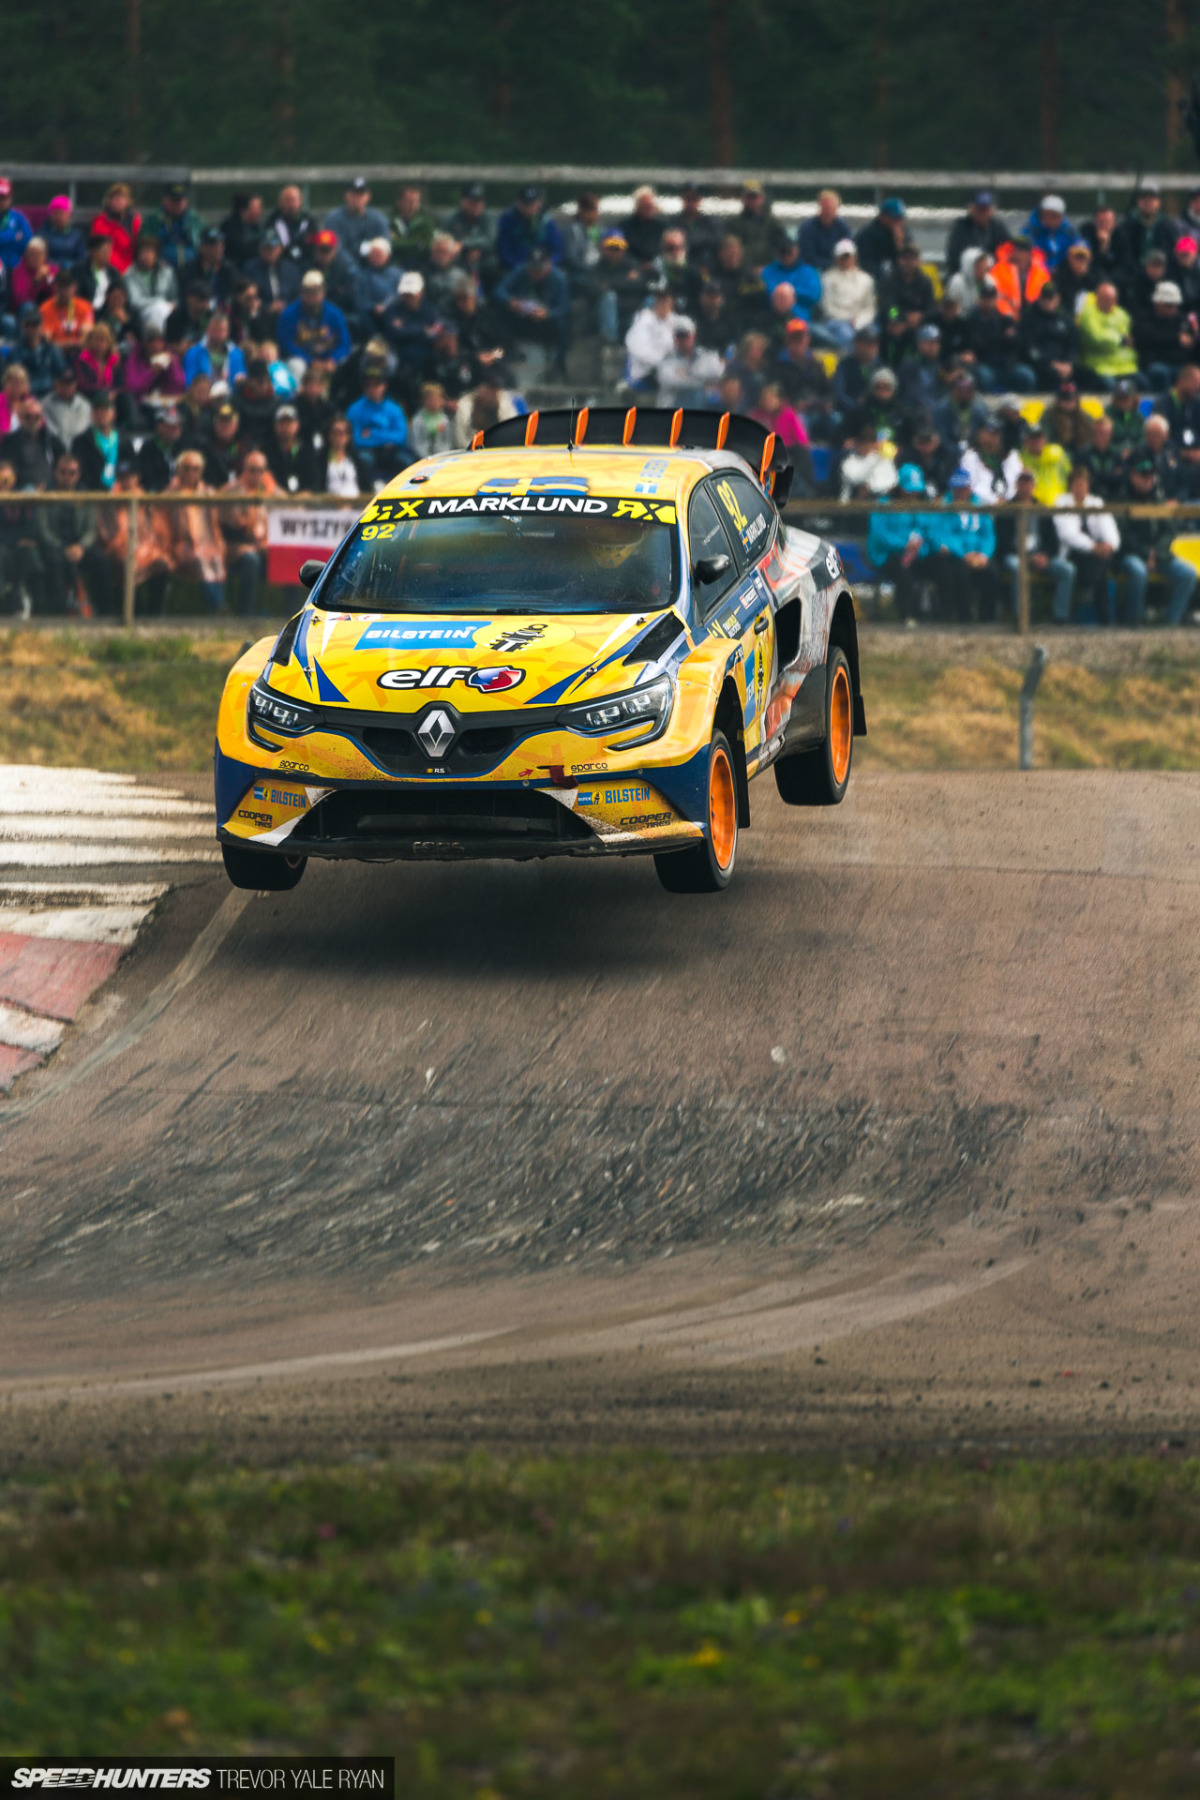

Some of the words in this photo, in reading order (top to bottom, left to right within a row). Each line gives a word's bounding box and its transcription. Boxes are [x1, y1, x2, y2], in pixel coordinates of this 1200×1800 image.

[428, 497, 608, 514] MARKLUND
[716, 480, 748, 531] 92
[361, 523, 396, 541] 92
[378, 665, 474, 690] elf
[279, 760, 310, 772] sparco
[570, 762, 608, 773] sparco
[270, 788, 307, 808] BILSTEIN
[605, 787, 650, 803] BILSTEIN
[238, 809, 273, 822] COOPER
[620, 812, 672, 826] COOPER
[645, 820, 671, 829] TIRES
